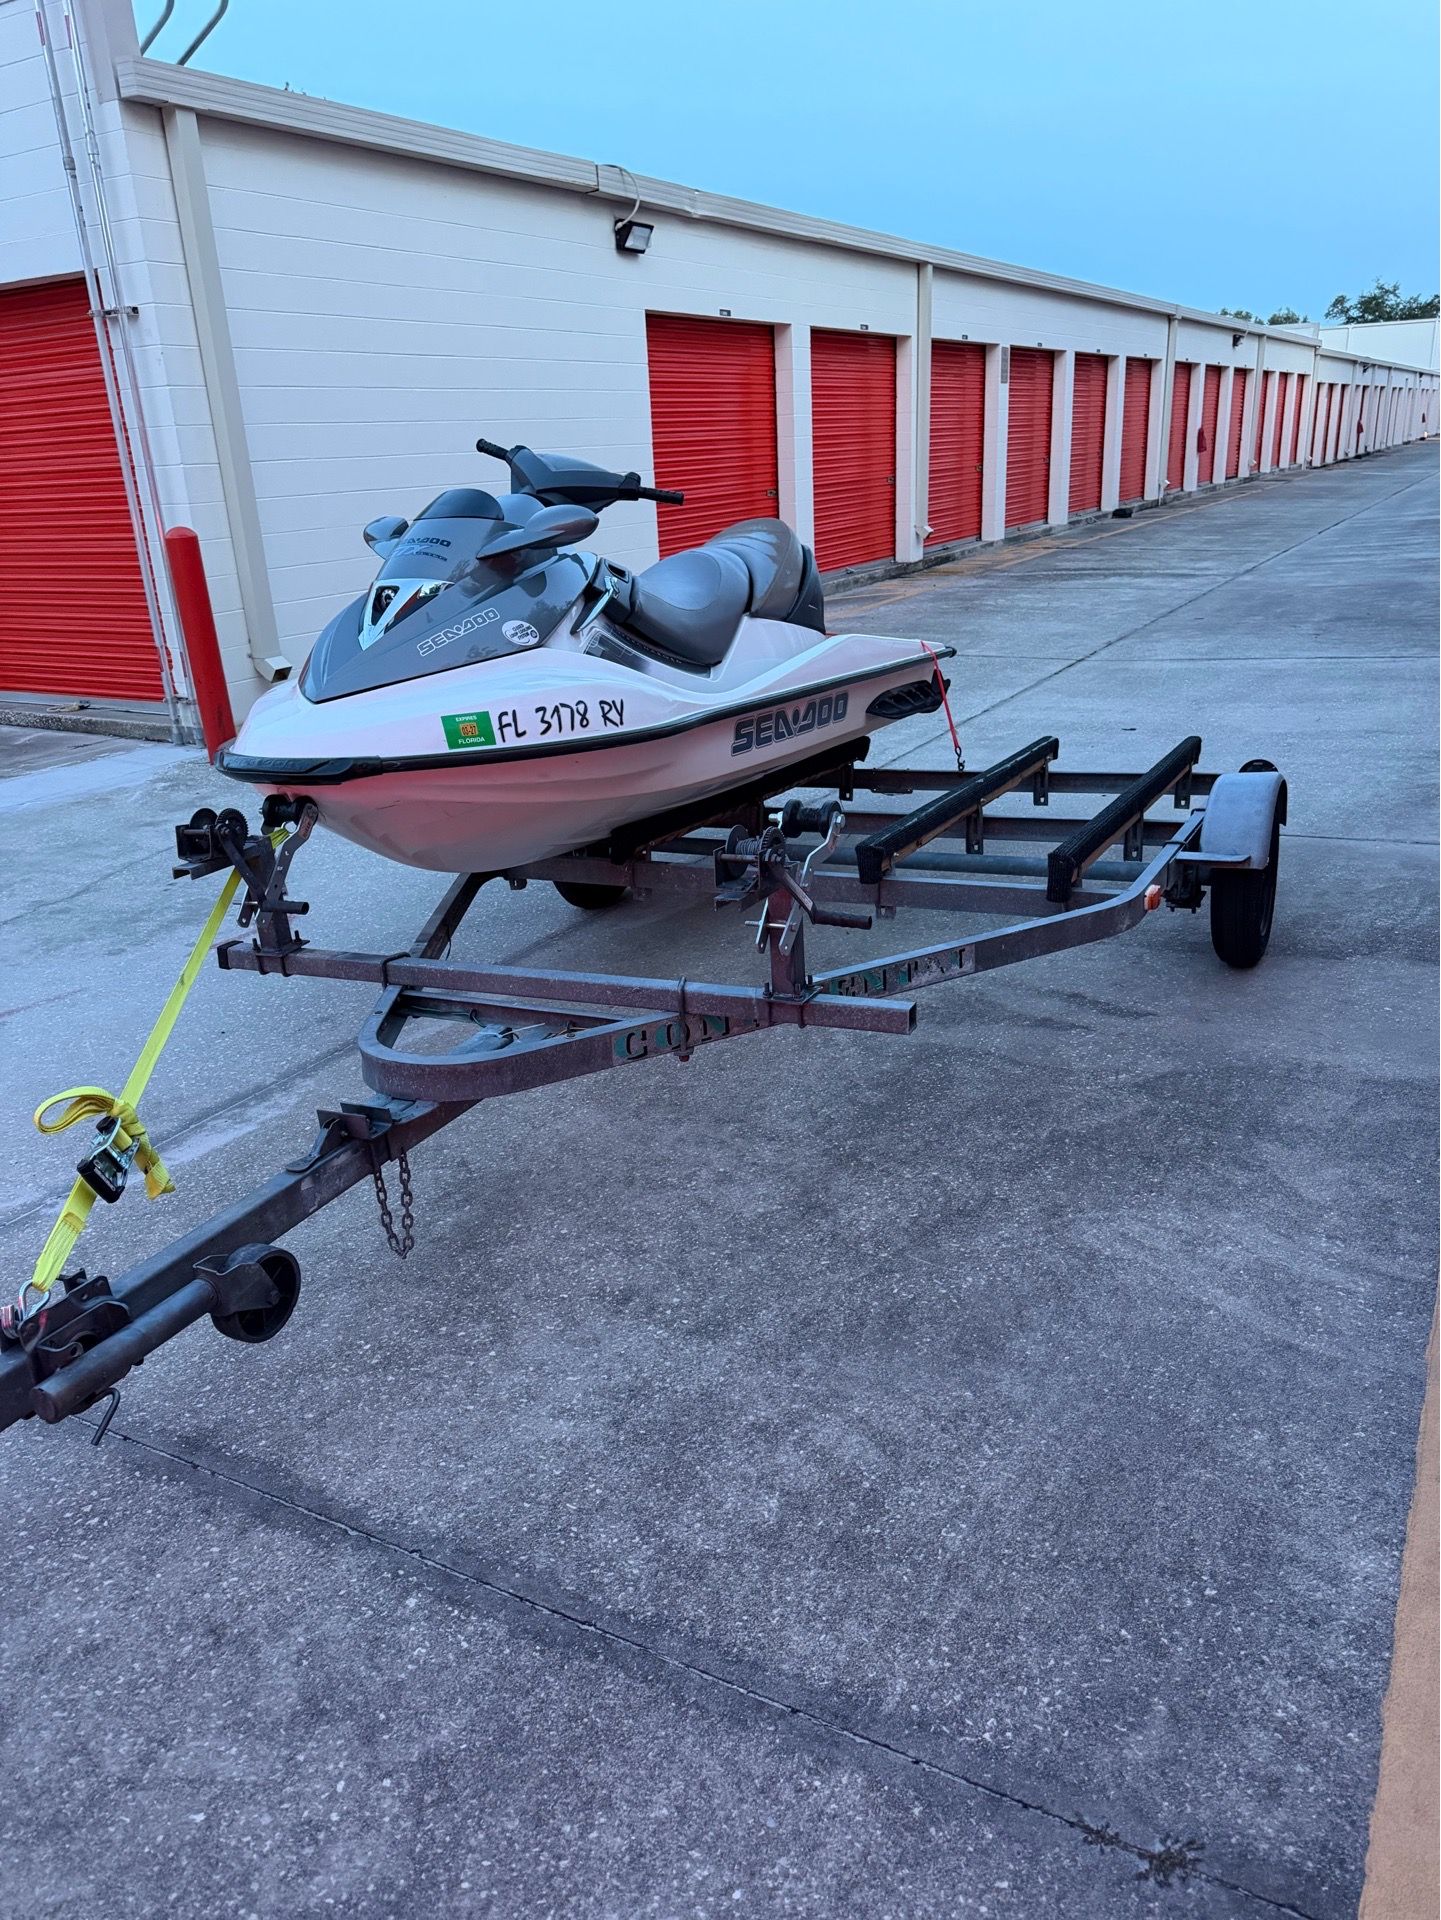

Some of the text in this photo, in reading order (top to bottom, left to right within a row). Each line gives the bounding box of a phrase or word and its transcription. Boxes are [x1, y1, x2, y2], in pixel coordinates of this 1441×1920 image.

[497, 709, 527, 743] FL
[535, 700, 590, 735] 3178
[458, 736, 486, 745] FLORIDA
